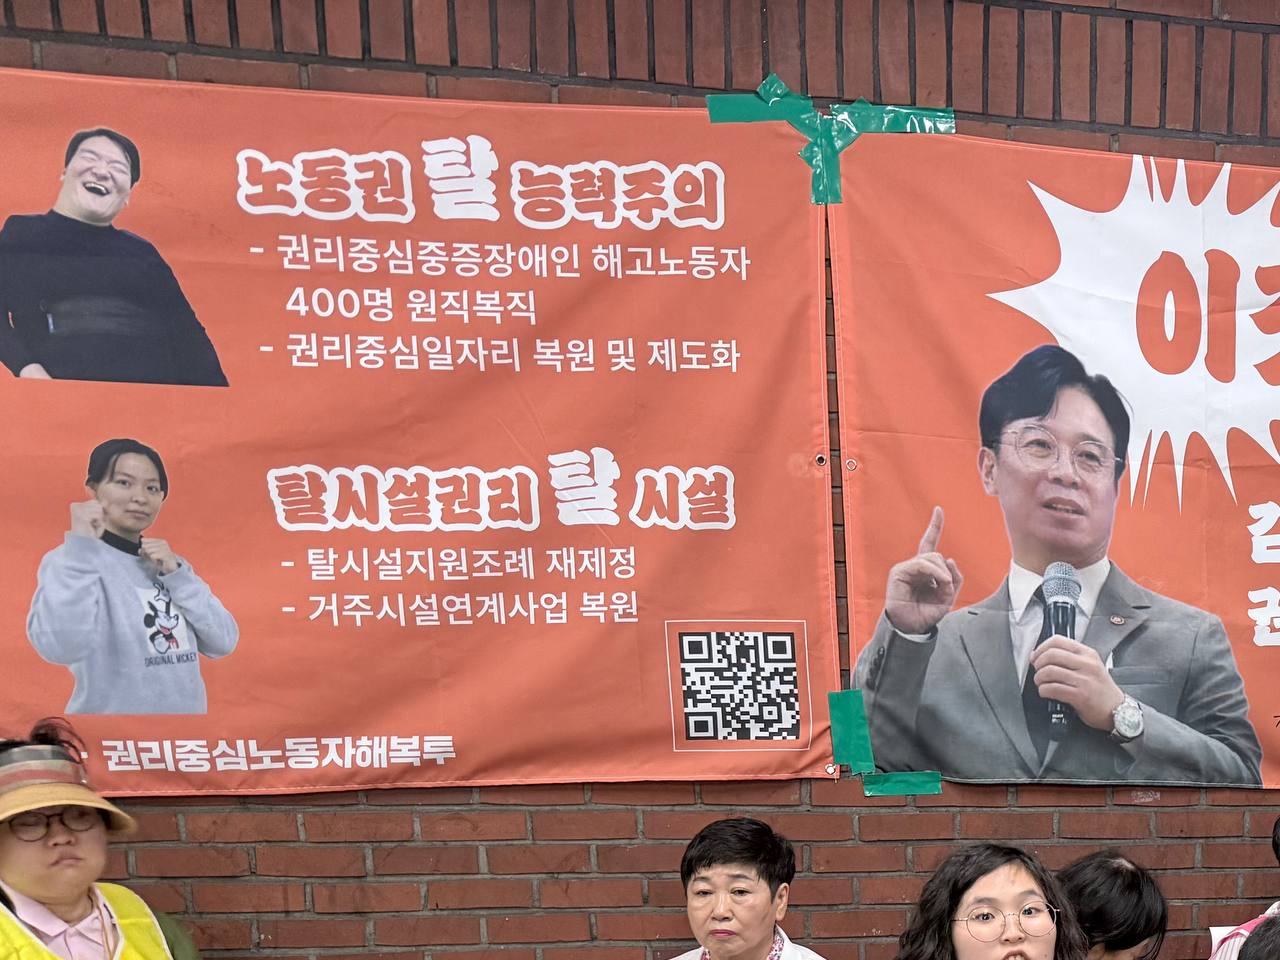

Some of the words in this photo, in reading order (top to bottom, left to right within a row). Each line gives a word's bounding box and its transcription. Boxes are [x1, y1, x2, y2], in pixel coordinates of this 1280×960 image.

[237, 149, 415, 223] 노동권
[421, 135, 500, 221] 탈
[510, 160, 725, 230] 능력주의
[277, 234, 580, 277] 권리중심중증장애인
[592, 244, 751, 280] 해고노동자
[286, 287, 394, 322] 400명
[406, 290, 536, 325] 원직복직
[287, 333, 520, 372] 권리중심일자리
[533, 338, 595, 372] 복원
[607, 337, 636, 371] 및
[648, 338, 740, 372] 제도화
[267, 464, 540, 532] 탈시설권리
[548, 447, 620, 526] 탈
[629, 465, 736, 530] 시설
[307, 546, 534, 581] 탈시설지원조례
[546, 546, 637, 579] 재제정
[308, 592, 568, 626] 거주시설연계사업
[579, 591, 638, 624] 복원
[102, 736, 455, 772] 권리중심노동자해복투
